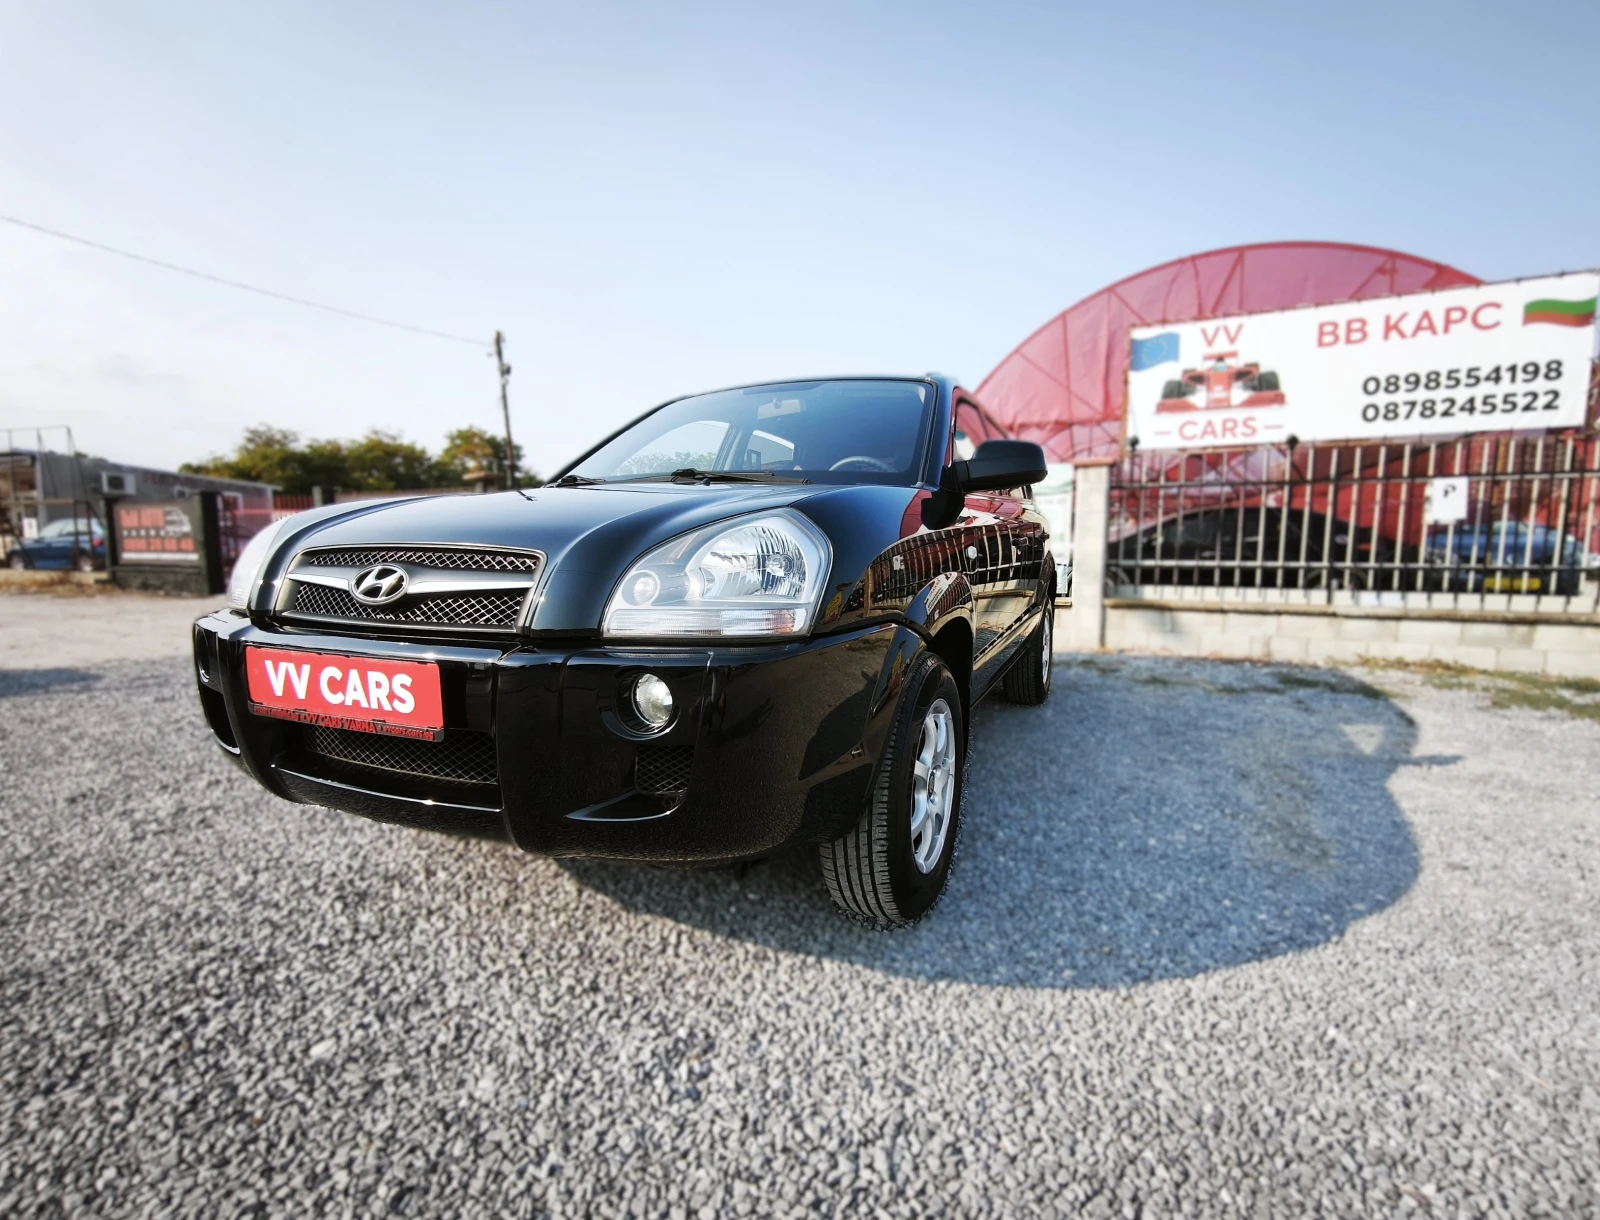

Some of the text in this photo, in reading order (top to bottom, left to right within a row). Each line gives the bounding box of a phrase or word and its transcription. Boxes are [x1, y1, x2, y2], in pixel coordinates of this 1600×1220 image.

[1200, 322, 1244, 347] VV
[1317, 301, 1503, 348] ВВ КАРС
[1361, 359, 1564, 396] 0898554198
[1360, 389, 1561, 423] 0878245522
[1178, 416, 1258, 441] CARS
[264, 659, 415, 714] VV CARS
[321, 715, 344, 728] CARS
[345, 718, 378, 734] VARNA
